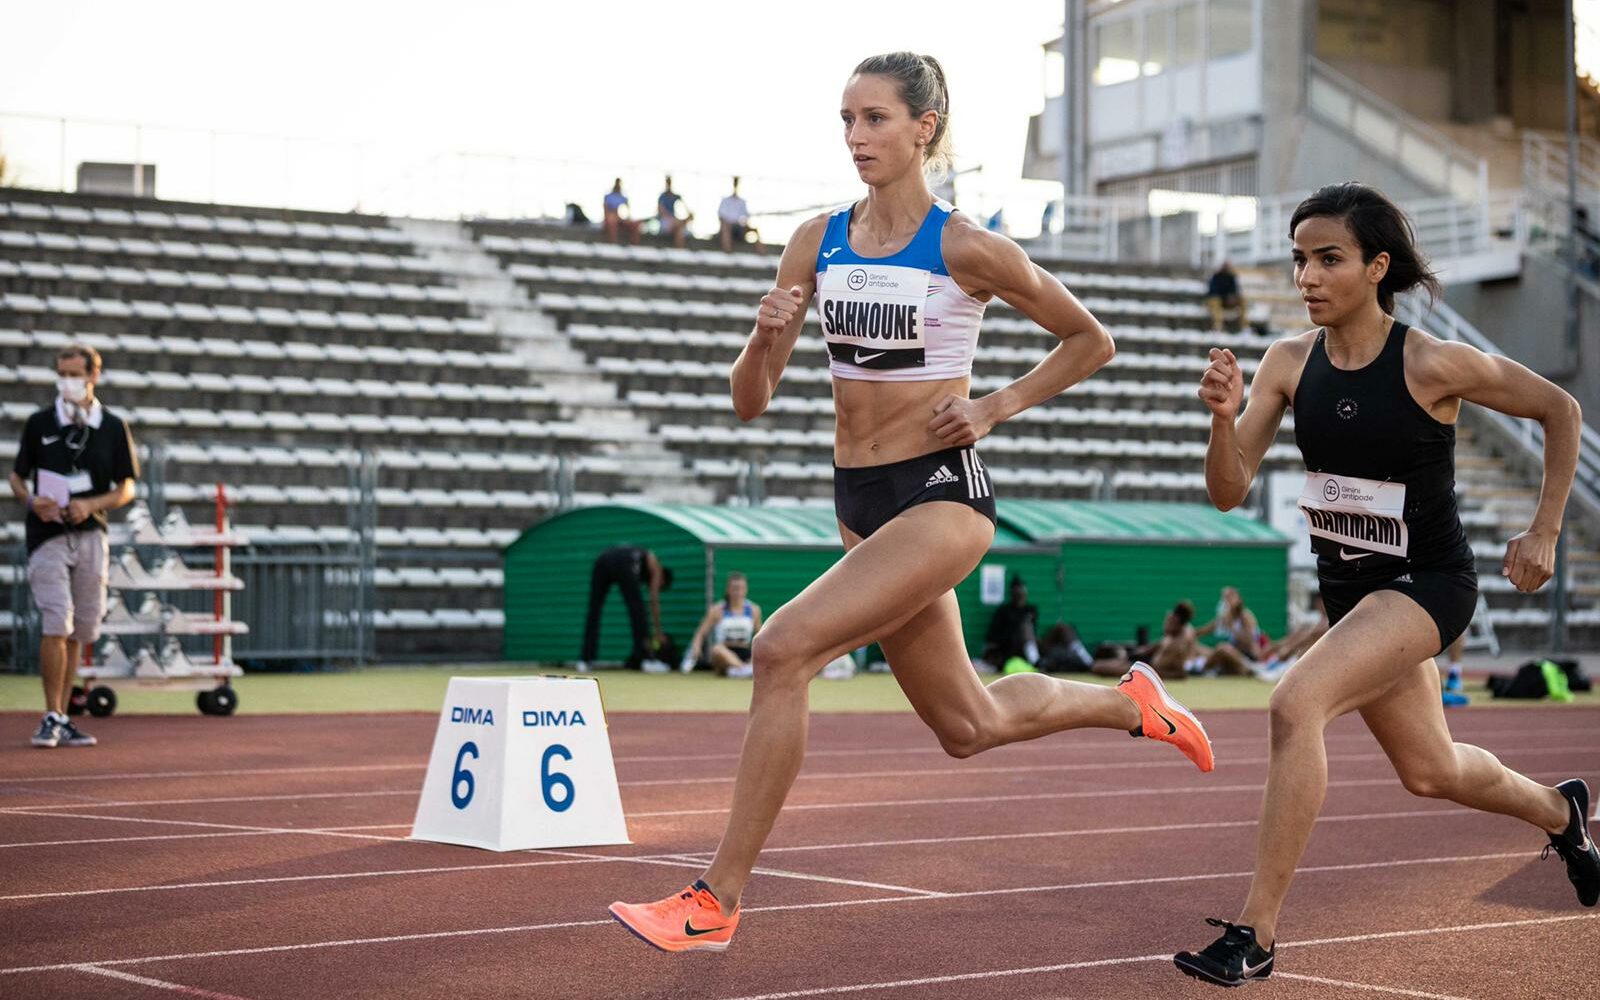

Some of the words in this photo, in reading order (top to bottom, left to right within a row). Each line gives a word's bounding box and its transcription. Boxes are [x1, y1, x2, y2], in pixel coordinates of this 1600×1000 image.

[824, 299, 918, 340] SAHNOUNE
[451, 706, 494, 726] DIMA
[522, 710, 586, 727] DIMA
[451, 741, 479, 810] 6
[541, 744, 575, 812] 6
